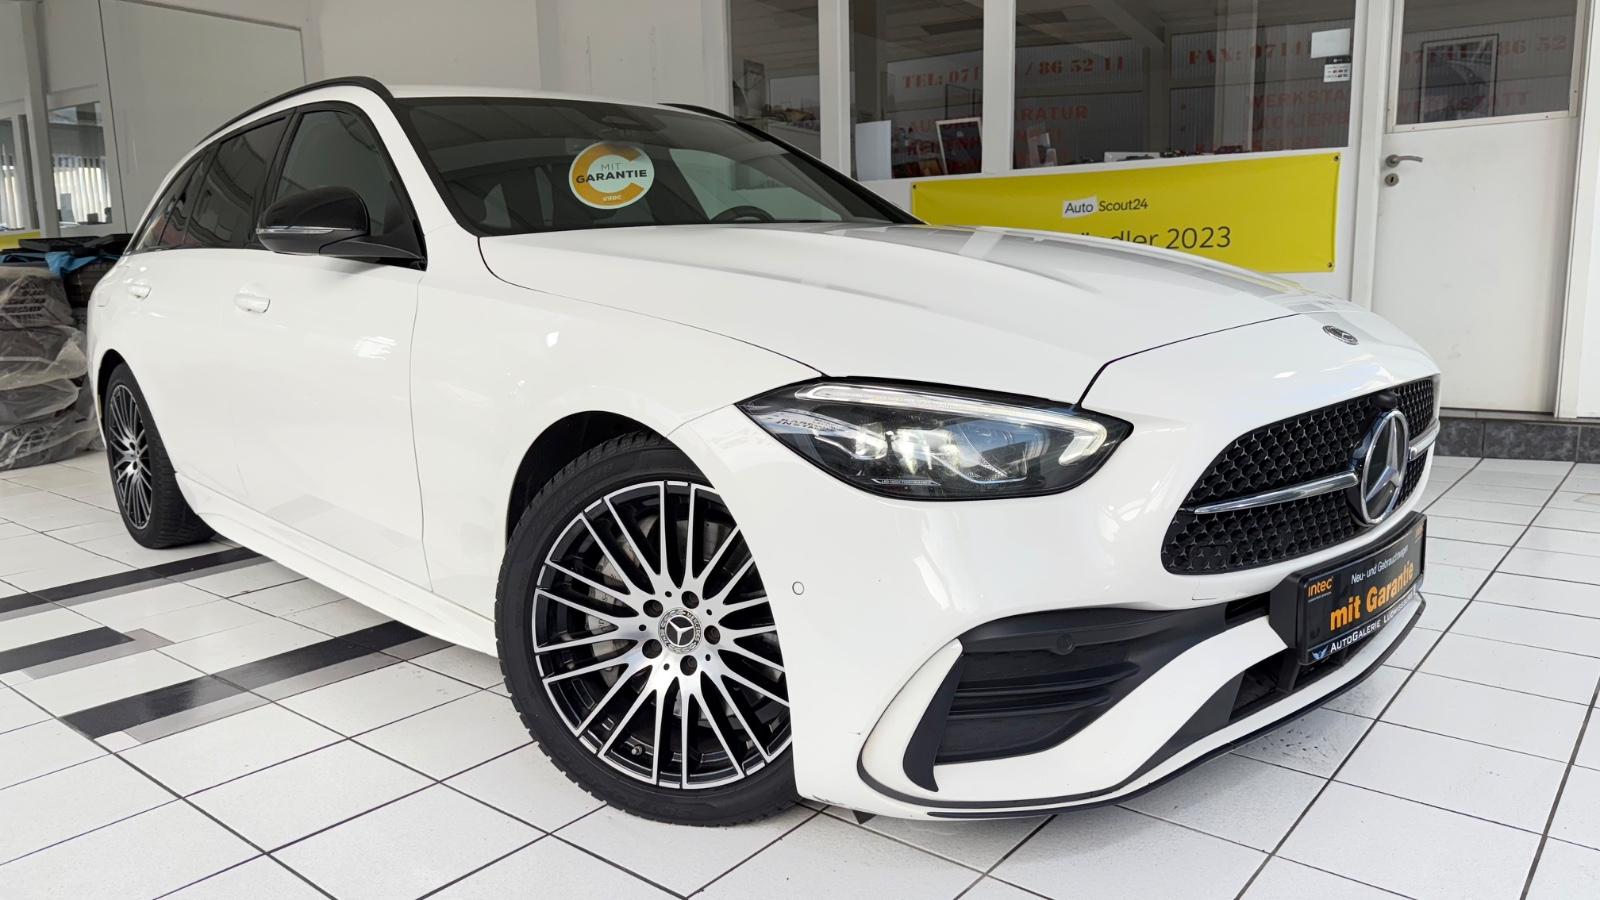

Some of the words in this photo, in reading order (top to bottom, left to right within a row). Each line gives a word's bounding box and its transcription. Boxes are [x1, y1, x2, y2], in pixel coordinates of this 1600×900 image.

[1039, 60, 1063, 76] 86
[1070, 58, 1094, 73] 52
[1103, 56, 1125, 72] 11
[601, 162, 624, 172] MIT
[576, 169, 648, 184] GARANTIE
[1098, 198, 1149, 212] Scout24
[1166, 226, 1231, 250] 2023
[1330, 594, 1361, 631] mit
[1366, 560, 1414, 613] Garantie
